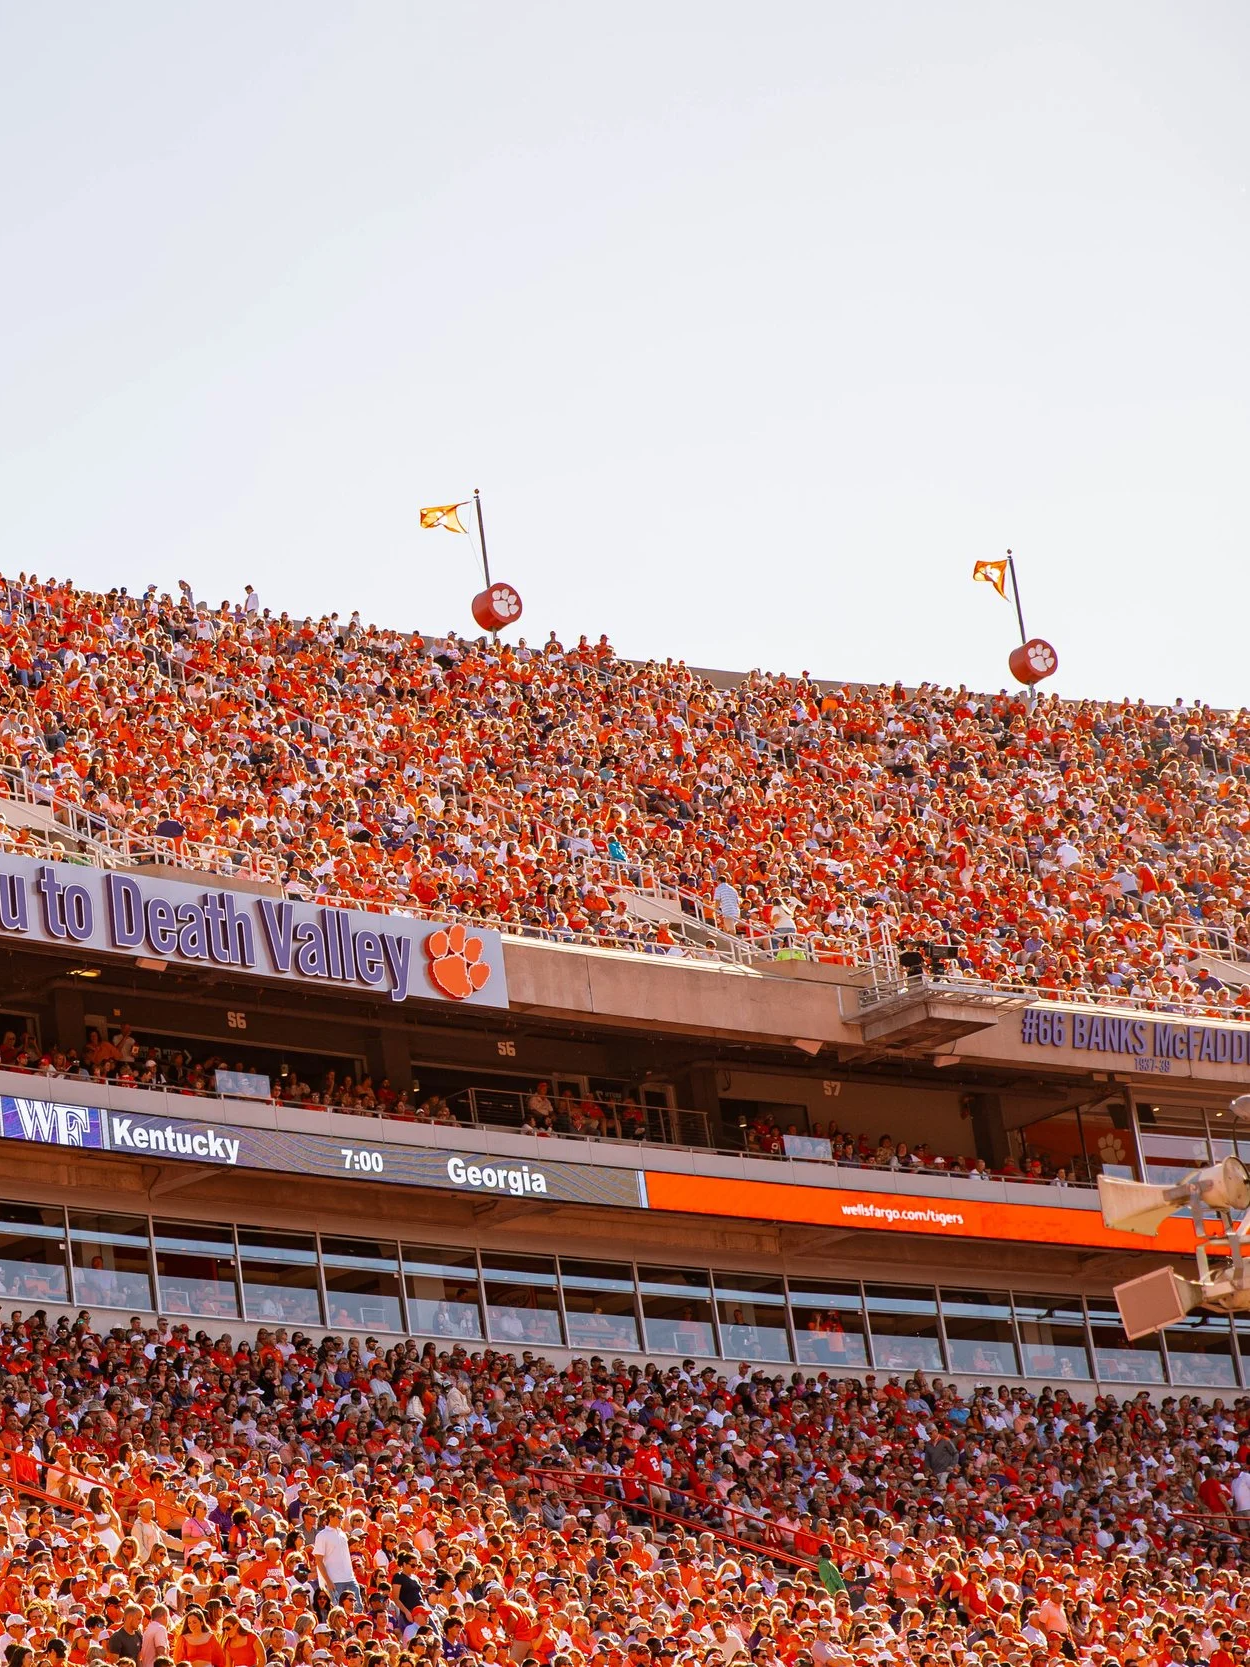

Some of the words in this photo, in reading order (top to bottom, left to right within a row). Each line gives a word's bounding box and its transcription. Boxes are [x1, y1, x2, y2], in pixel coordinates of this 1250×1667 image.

[40, 866, 95, 941] to
[108, 873, 256, 967] Death
[258, 897, 411, 1002] Valley
[227, 1011, 247, 1029] S6
[1022, 1009, 1066, 1047] #66
[1072, 1013, 1147, 1055] BANKS
[1154, 1021, 1250, 1064] McFADD
[497, 1041, 517, 1057] S6
[1134, 1057, 1171, 1073] 1937-39
[822, 1081, 841, 1097] S7
[14, 1098, 91, 1147] WF
[111, 1116, 240, 1166] Kentucky
[341, 1147, 384, 1173] 7:00
[447, 1157, 548, 1195] Georgia
[840, 1203, 964, 1227] wellsfargo.com/tigers
[649, 1457, 660, 1472] 2
